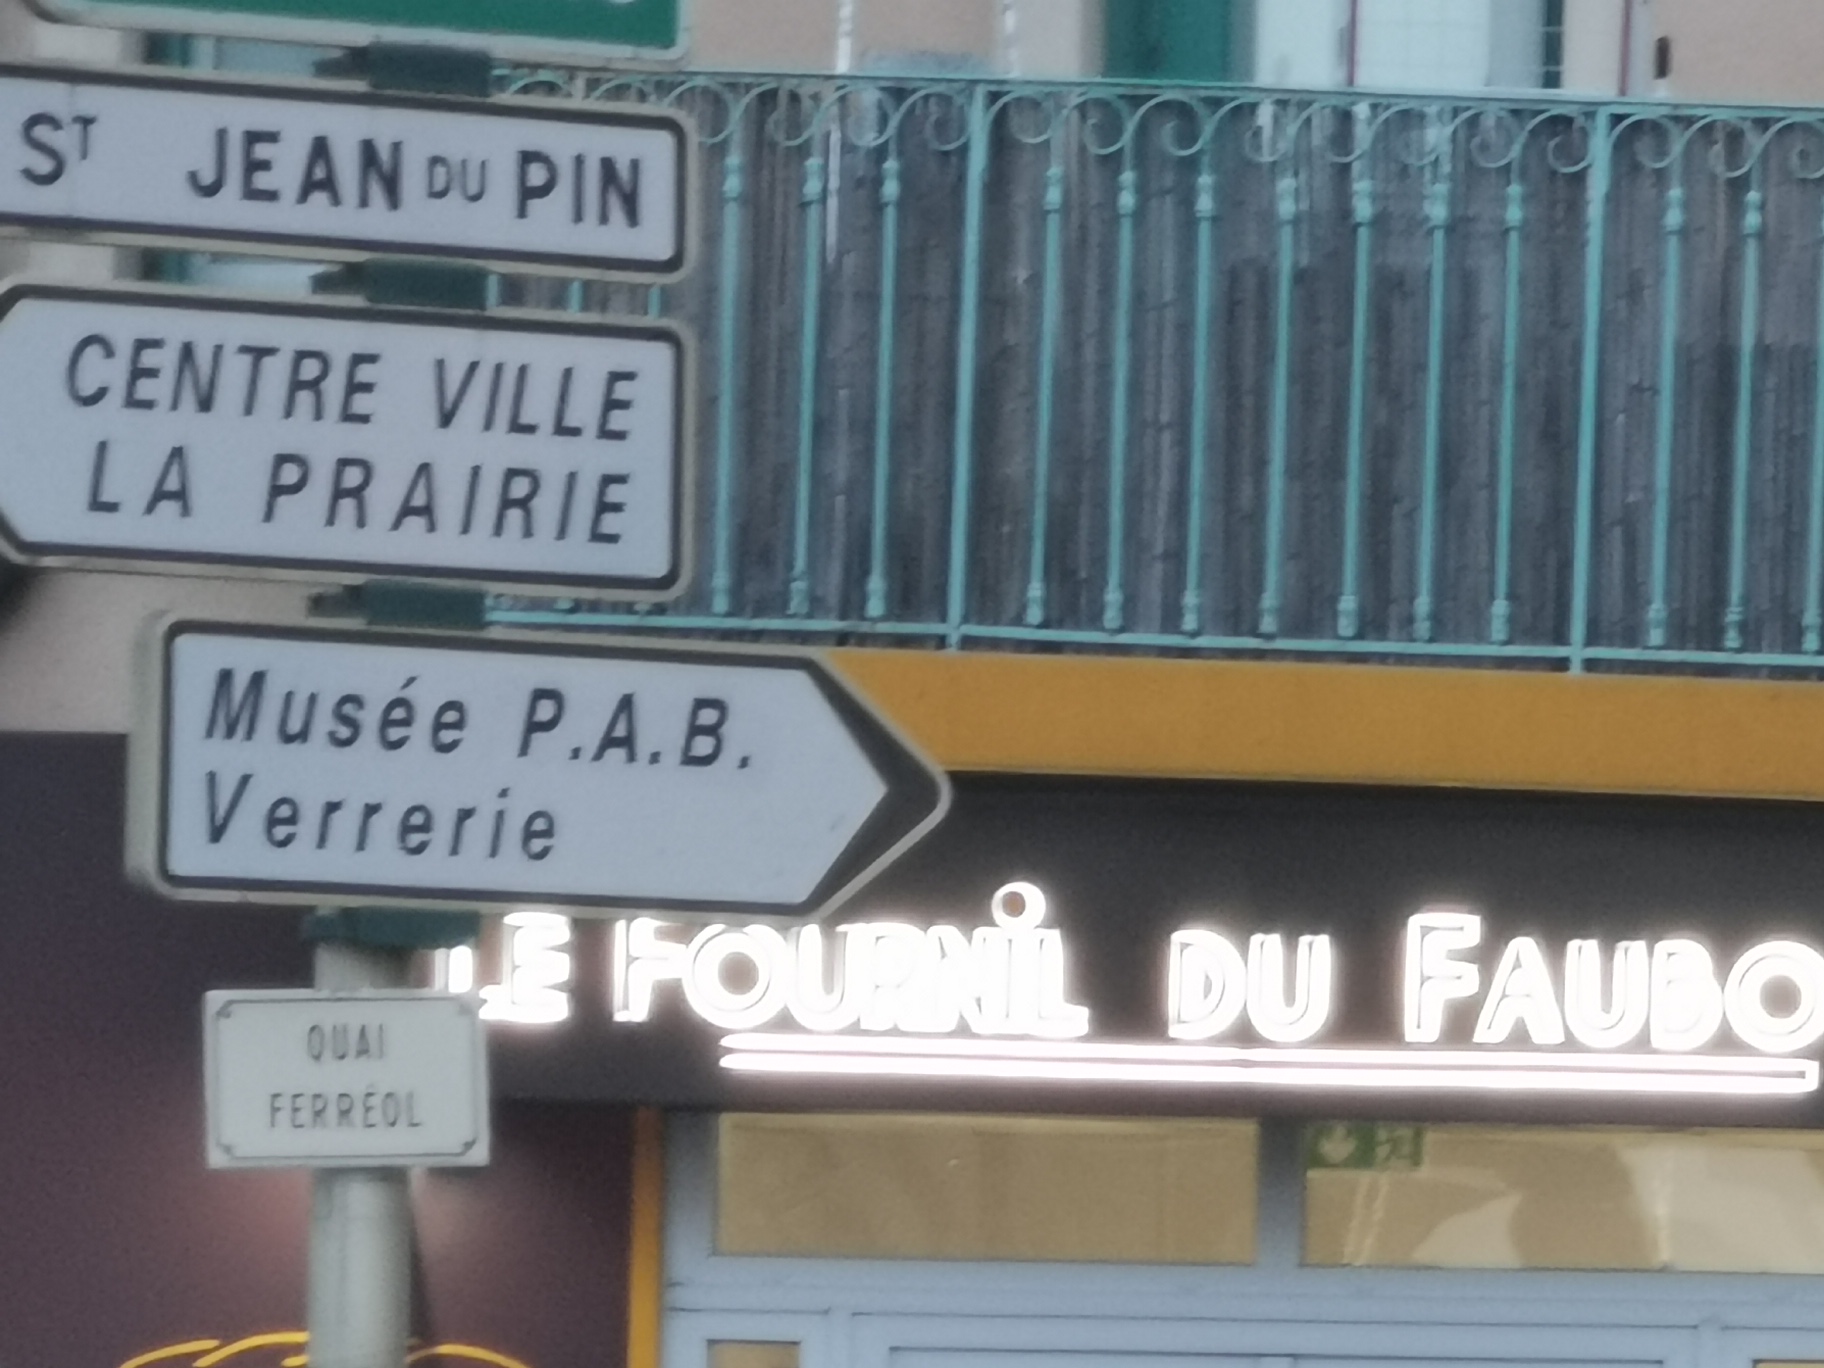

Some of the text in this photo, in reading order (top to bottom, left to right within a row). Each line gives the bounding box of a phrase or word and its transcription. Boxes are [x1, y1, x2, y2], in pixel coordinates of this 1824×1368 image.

[188, 127, 404, 212] JEAN
[426, 155, 487, 203] DU
[516, 150, 642, 229] PIN
[67, 334, 639, 442] CENTRE VILLE
[87, 441, 630, 546] LA PRAIRIE
[205, 669, 754, 770] Musée P.A.B.
[203, 770, 559, 861] Verrerie
[1168, 928, 1332, 1044] DU
[306, 1023, 385, 1061] QUAI
[269, 1083, 422, 1129] FERRÉOL
